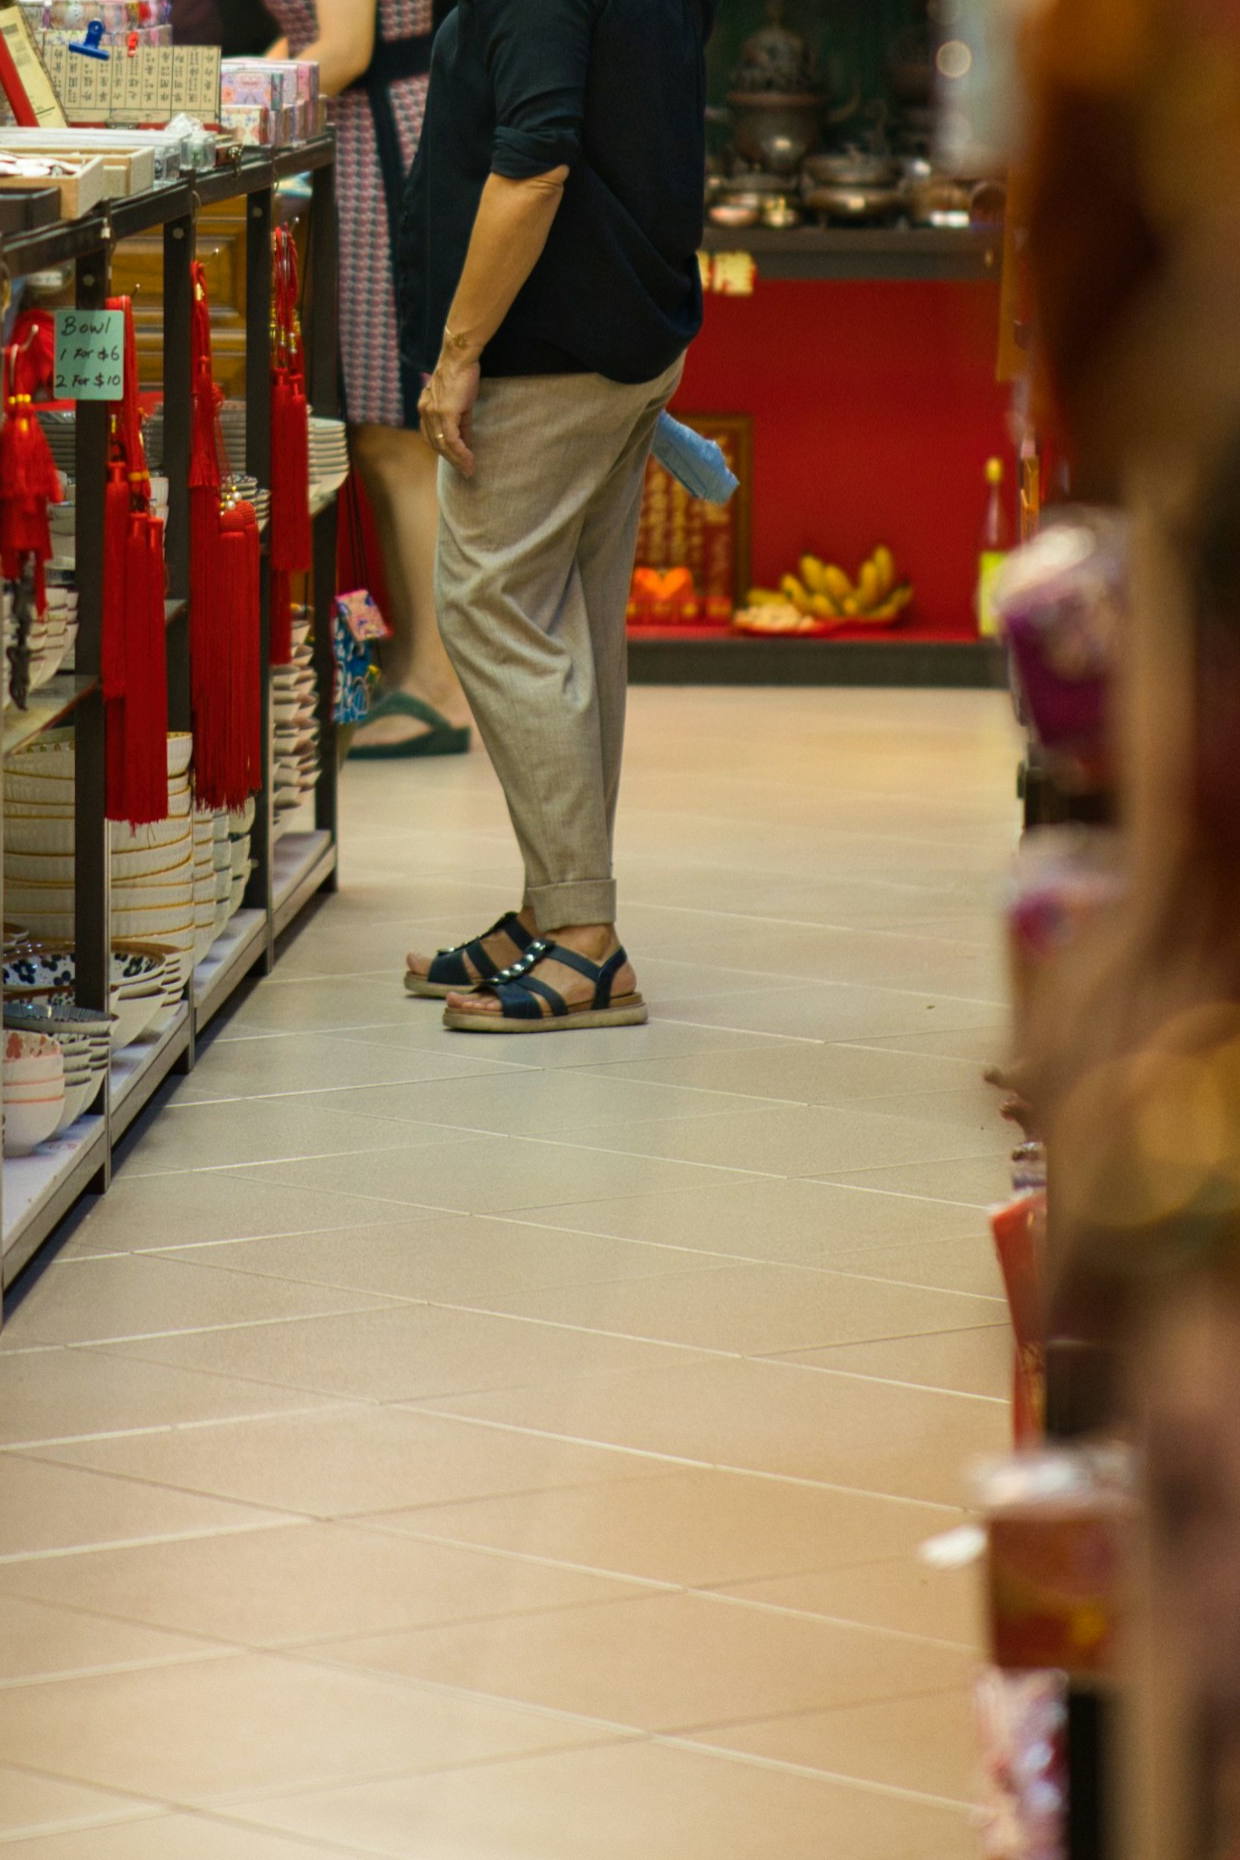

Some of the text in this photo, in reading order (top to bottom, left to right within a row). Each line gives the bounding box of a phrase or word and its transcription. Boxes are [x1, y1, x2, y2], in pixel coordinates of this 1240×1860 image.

[61, 315, 112, 336] Bowl
[60, 348, 67, 361] 1
[97, 344, 120, 362] $6
[55, 373, 68, 388] 2
[93, 371, 121, 389] $10
